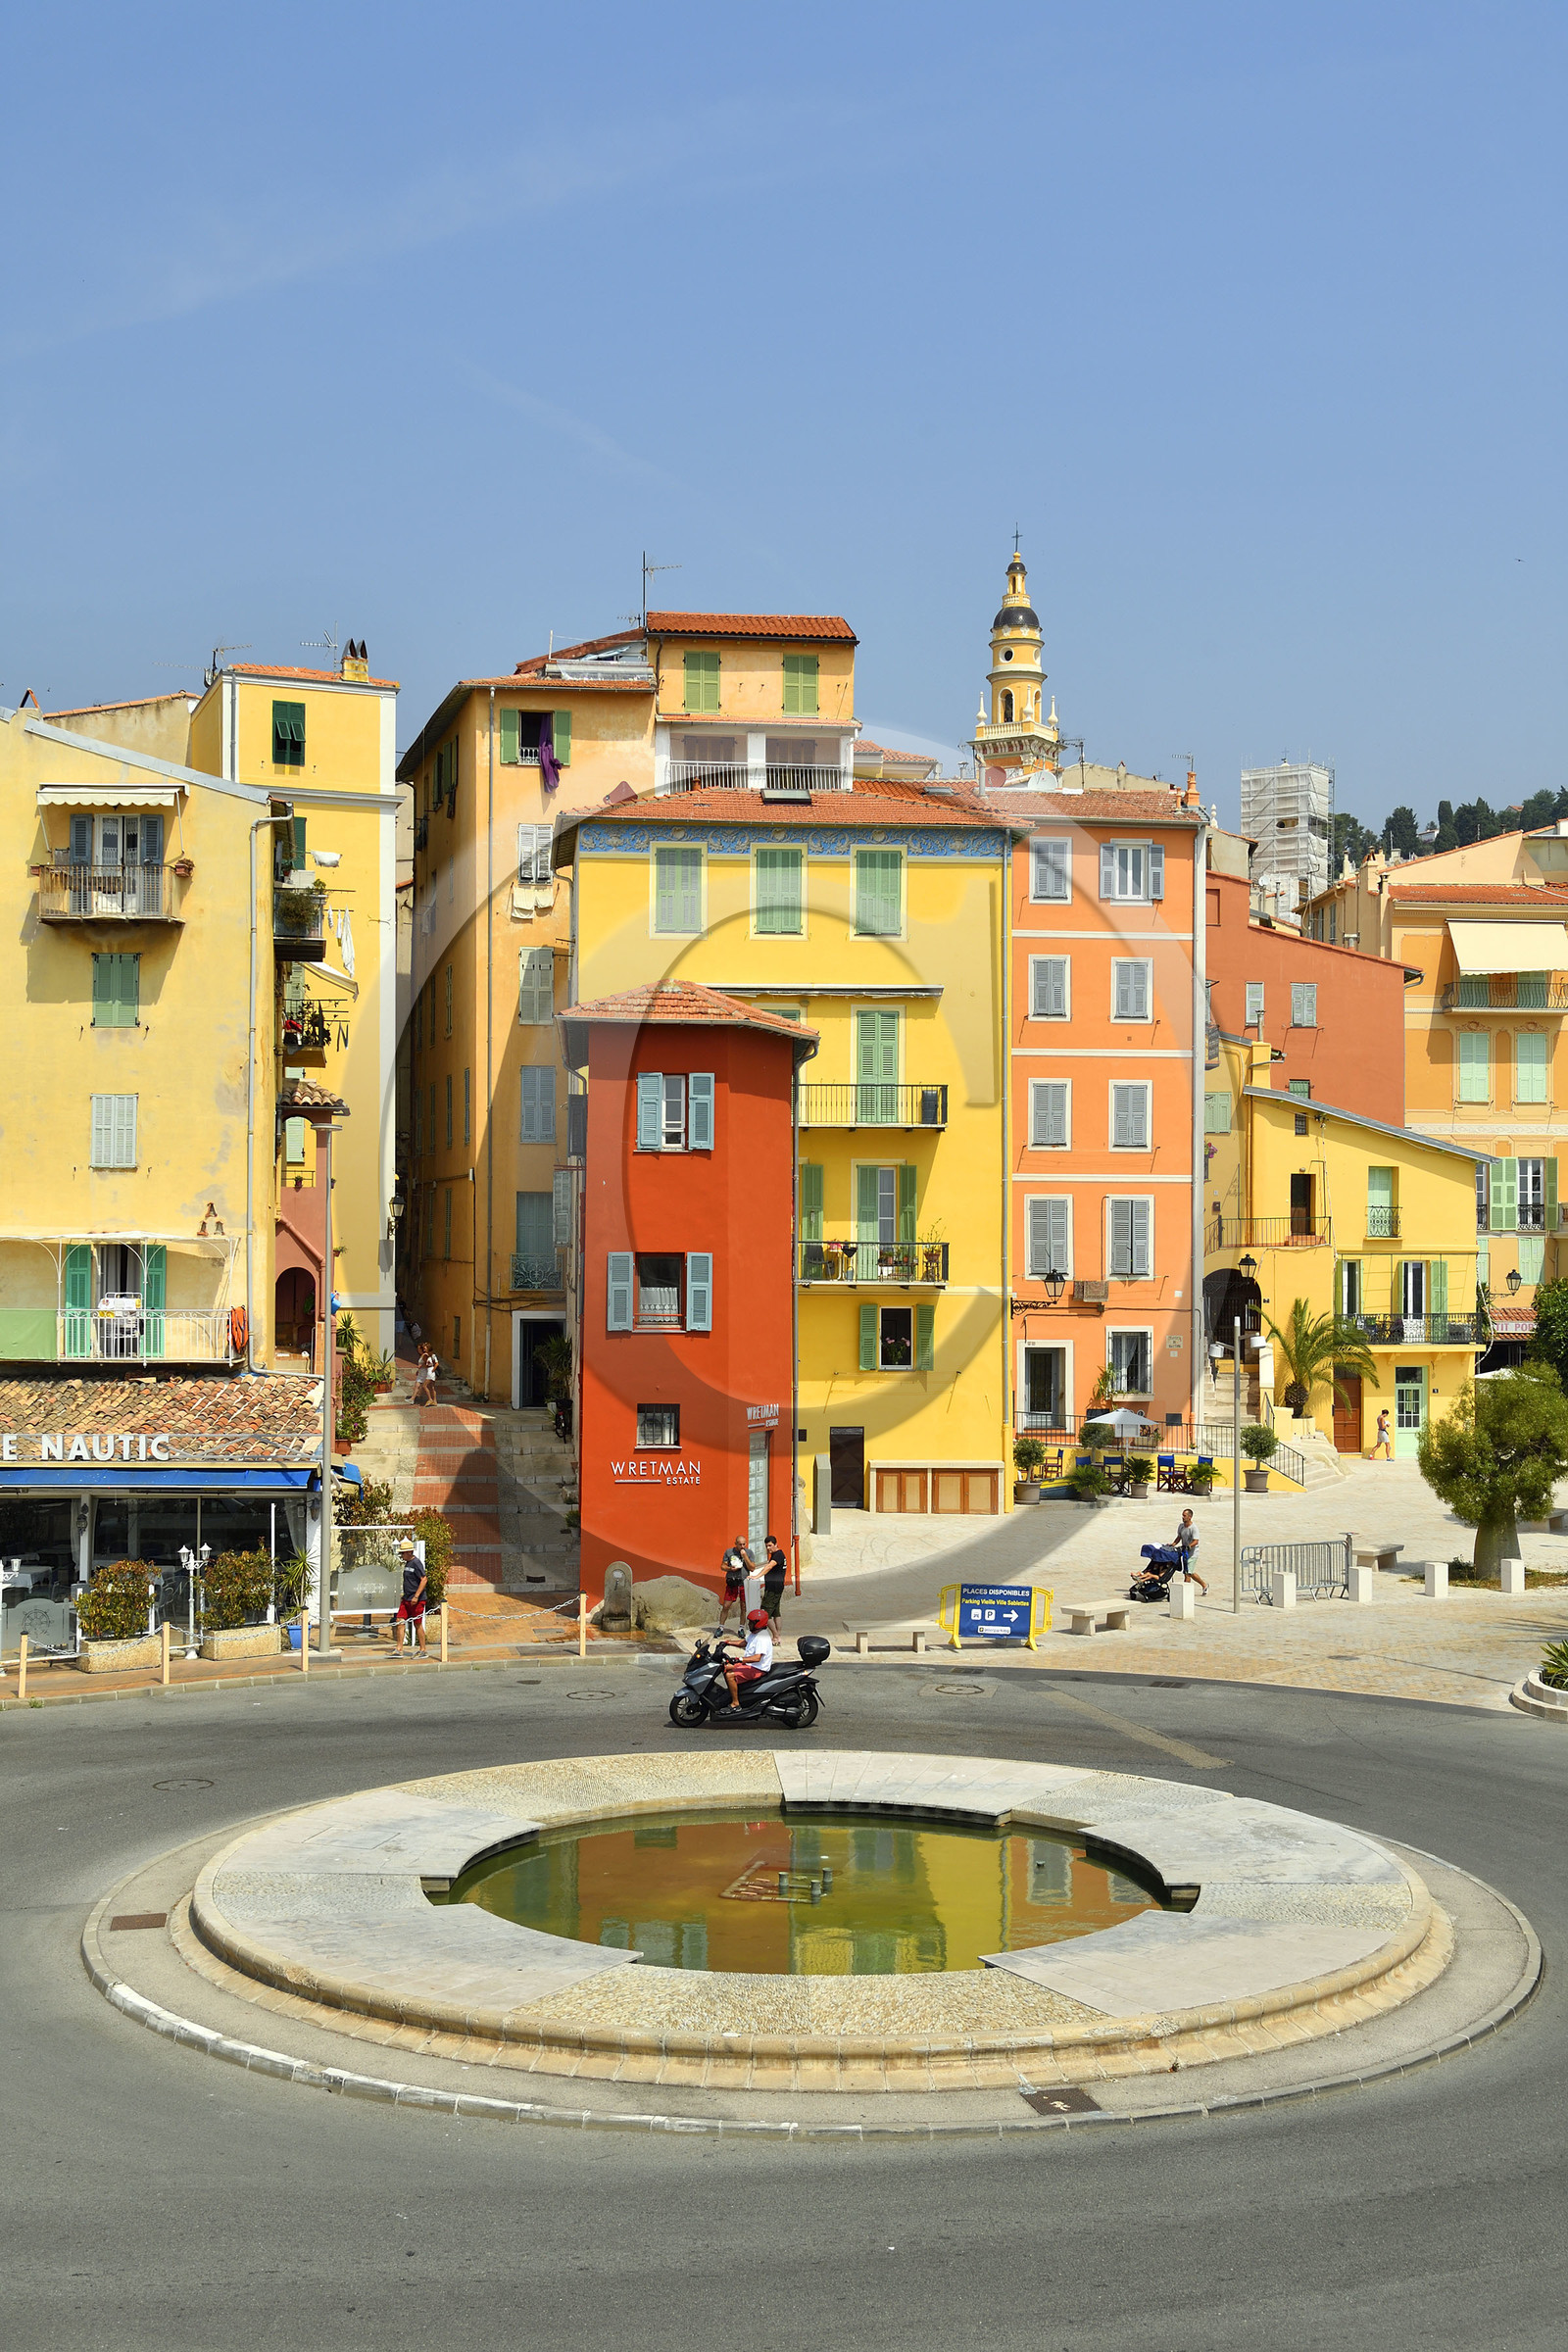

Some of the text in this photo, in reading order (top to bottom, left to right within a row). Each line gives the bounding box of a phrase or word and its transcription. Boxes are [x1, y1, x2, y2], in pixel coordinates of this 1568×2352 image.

[746, 1403, 779, 1420] WRETMAN
[41, 1434, 170, 1461] NAUTIC
[611, 1460, 701, 1476] WRETMAN
[666, 1476, 701, 1485] ESTATE
